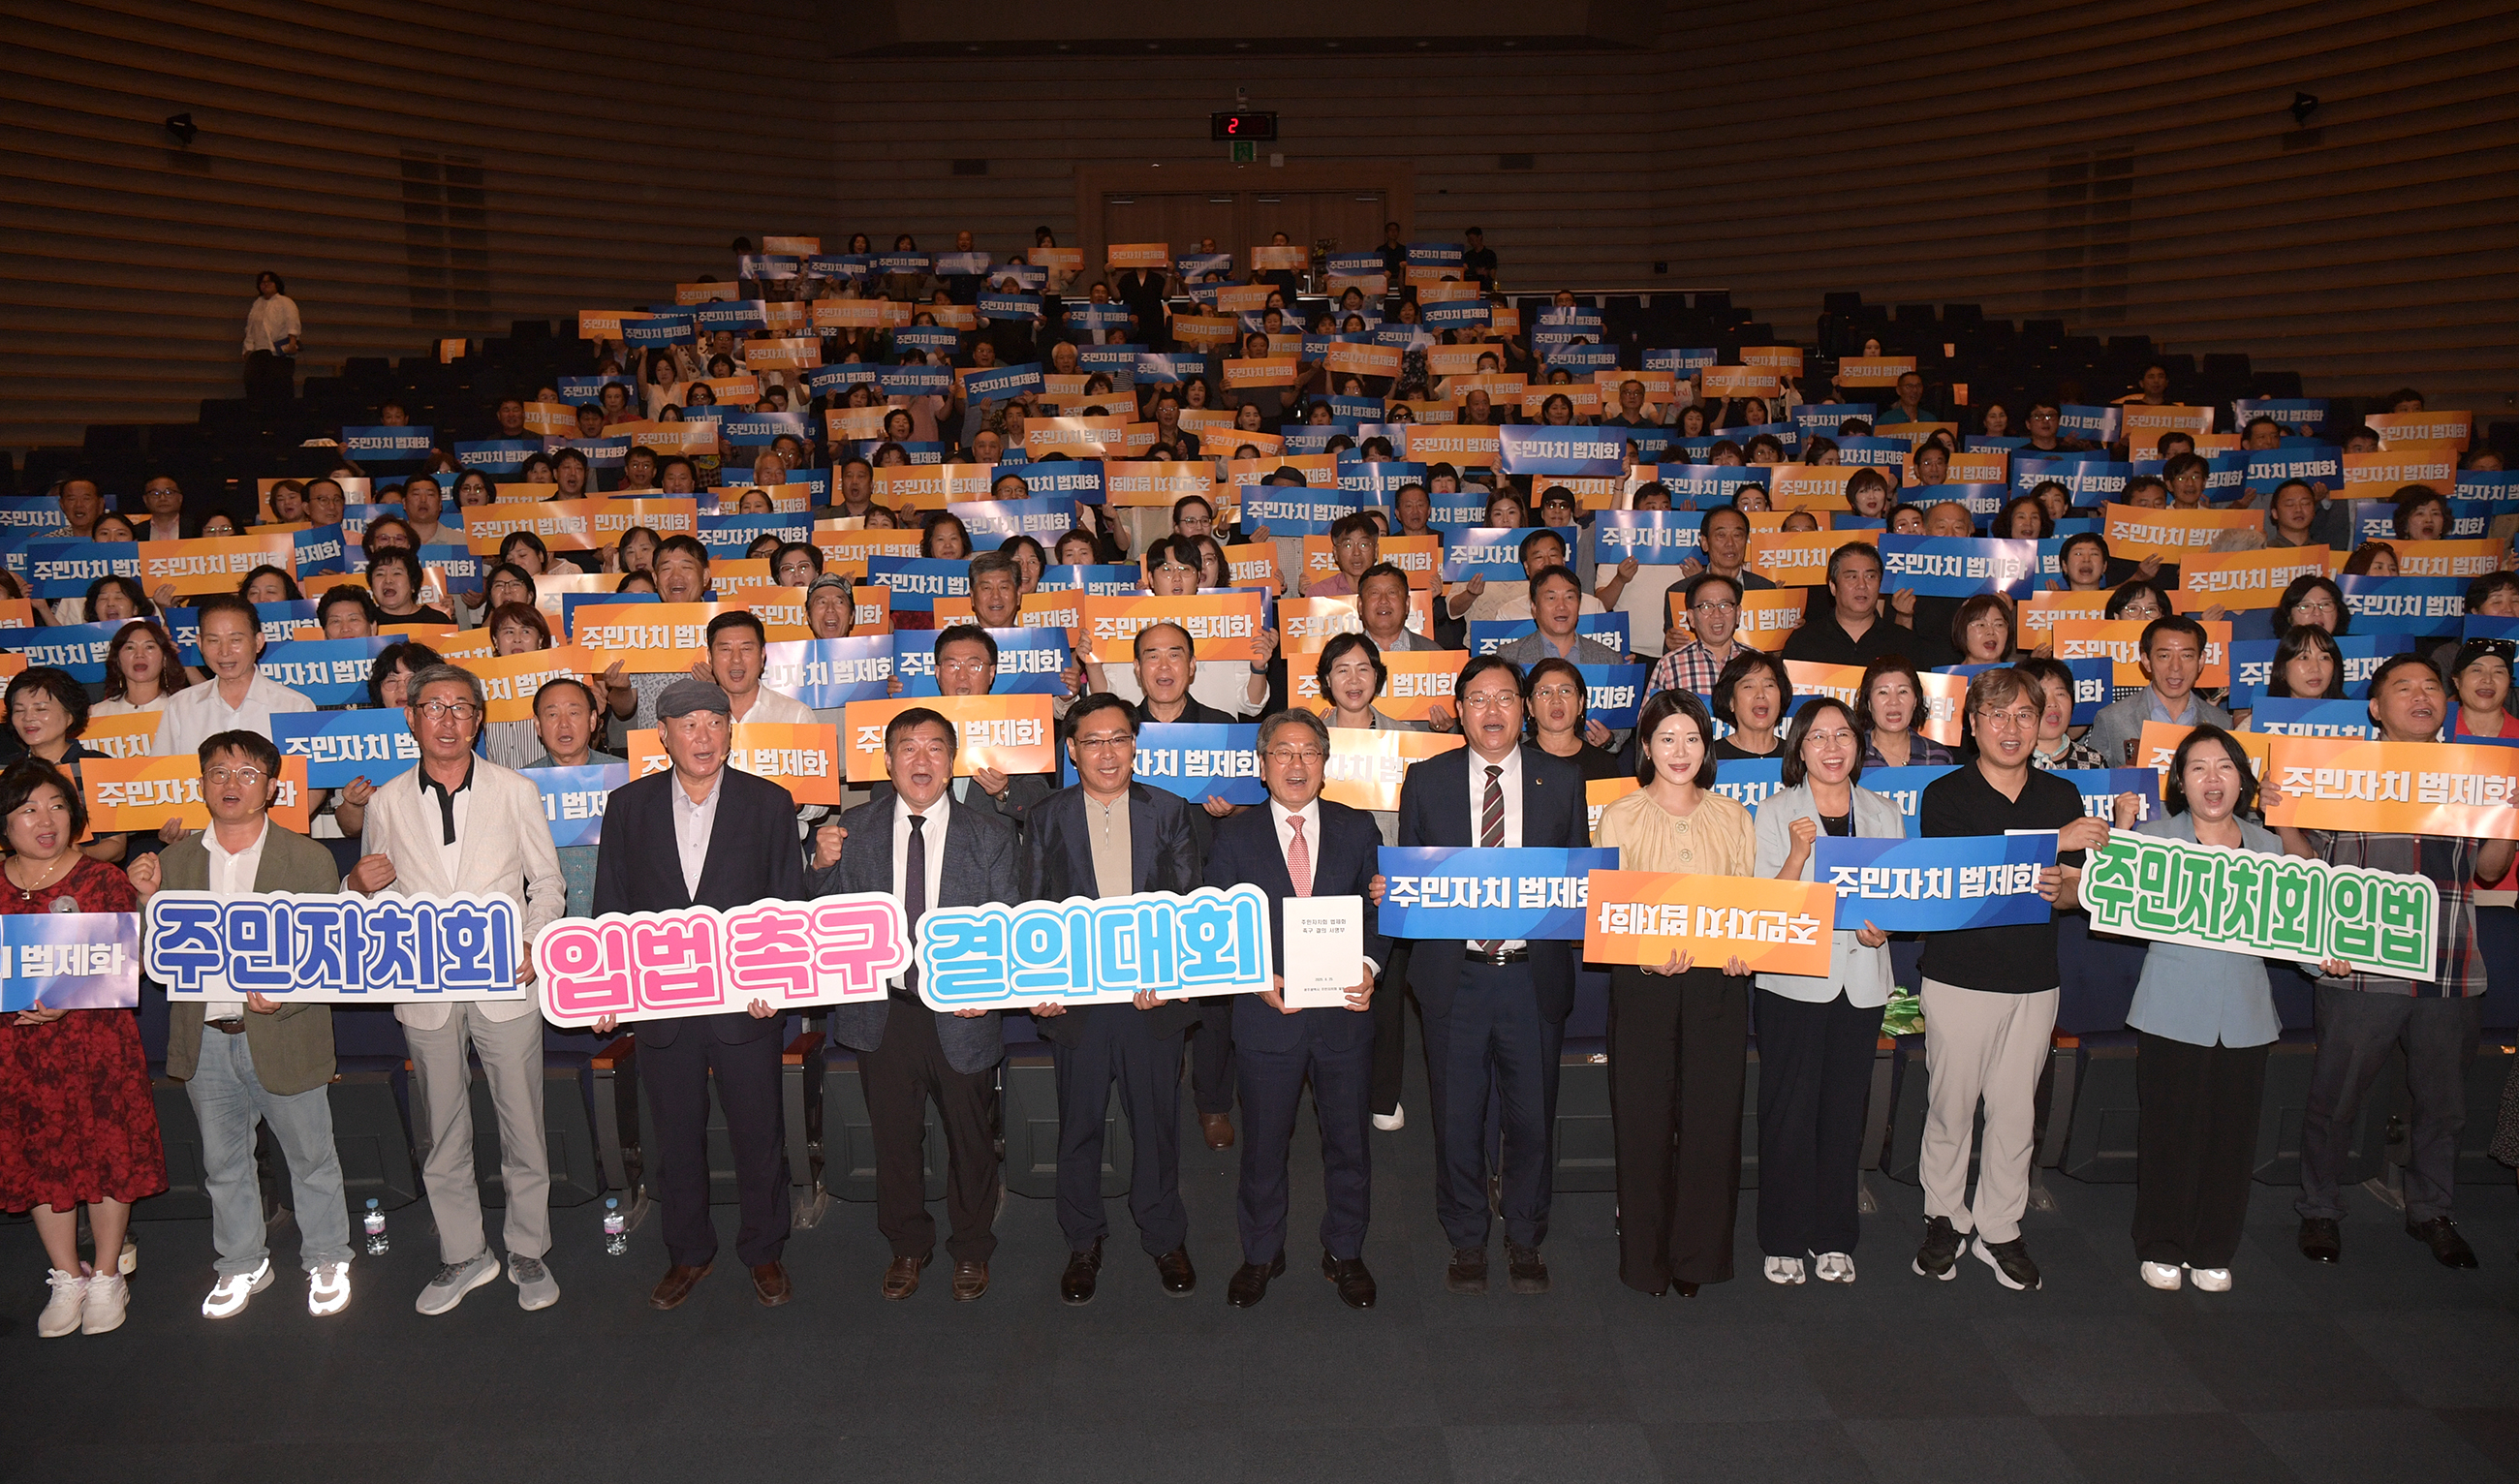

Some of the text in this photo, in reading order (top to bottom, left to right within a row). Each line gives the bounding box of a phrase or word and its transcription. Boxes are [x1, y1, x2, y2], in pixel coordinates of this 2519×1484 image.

[1228, 118, 1238, 133] 2
[1409, 250, 1462, 260] 주민자치 법제화
[812, 262, 866, 273] 주민자치 법제화
[880, 259, 906, 267] 주민자치
[1221, 293, 1252, 302] 주민자치
[980, 300, 1040, 313] 주민자치 법제화
[699, 310, 733, 321] 주민자치
[736, 310, 763, 321] 법제화
[1104, 312, 1128, 322] 법제화
[1426, 309, 1488, 321] 주민자치 법제화
[1540, 315, 1601, 325] 주민자치 법제화
[583, 320, 620, 329] 주민자치
[626, 325, 690, 338] 주민자치 법제화
[1175, 324, 1233, 335] 주민자치 법제화
[897, 335, 956, 345] 주민자치 법제화
[1378, 331, 1412, 341] 주민자치
[1536, 333, 1570, 343] 주민자치
[749, 349, 817, 358] 주민자치 법제화
[1081, 352, 1116, 362] 주민자치
[1330, 351, 1397, 367] 주민자치 법제화
[1432, 355, 1469, 364] 주민자치
[1548, 355, 1616, 364] 주민자치 법제화
[1744, 356, 1800, 366] 주민자치 법제화
[1137, 362, 1203, 374] 주민자치 법제화
[1647, 357, 1713, 369] 주민자치 법제화
[1843, 365, 1912, 376] 주민자치 법제화
[813, 371, 876, 387] 주민자치 법제화
[1228, 366, 1292, 378] 주민자치 법제화
[882, 375, 949, 386] 주민자치 법제화
[970, 372, 1041, 393] 주민자치 법제화
[1706, 376, 1776, 386] 주민자치 법제화
[727, 386, 755, 395] 법제화
[1495, 384, 1523, 393] 법제화
[552, 414, 575, 425] 법제화
[1353, 407, 1381, 418] 법제화
[1422, 411, 1454, 421] 법제화
[2289, 409, 2323, 421] 법제화
[831, 418, 872, 430] 주민자치
[1796, 415, 1838, 426] 주민자치
[2128, 416, 2172, 427] 주민자치
[727, 424, 769, 436] 주민자치
[1030, 428, 1122, 445] 주민자치 법제화
[2432, 424, 2467, 438] 법제화
[348, 438, 429, 448] 주민자치 법제화
[638, 432, 713, 444] 주민자치 법제화
[1127, 434, 1155, 446] 법제화
[1205, 435, 1279, 454] 주민자치 법제화
[1286, 436, 1326, 447] 주민자치
[1412, 438, 1464, 452] 주민자치
[461, 451, 502, 464] 주민자치
[596, 447, 628, 457] 법제화
[910, 452, 942, 464] 법제화
[1508, 442, 1620, 459] 주민자치 법제화
[1874, 450, 1905, 464] 법제화
[1962, 467, 2001, 480] 법제화
[2289, 461, 2337, 478] 법제화
[2404, 464, 2449, 479] 법제화
[892, 477, 991, 495] 주민자치 법제화
[1057, 475, 1100, 491] 법제화
[1108, 477, 1211, 492] 주민자치 법제화
[1662, 478, 1718, 495] 주민자치
[1779, 480, 1836, 495] 주민자치
[2082, 475, 2126, 491] 법제화
[1248, 502, 1309, 520] 주민자치
[1965, 498, 2001, 512] 법제화
[472, 516, 586, 539] 주민자치 법제화
[644, 513, 690, 531] 법제화
[1023, 513, 1071, 531] 법제화
[698, 530, 755, 544] 주민자치
[1602, 528, 1670, 546] 주민자치
[2112, 521, 2185, 545] 주민자치
[822, 544, 883, 563] 주민자치
[1450, 546, 1519, 564] 주민자치
[1758, 549, 1825, 568] 주민자치
[149, 556, 225, 575] 주민자치
[1383, 552, 1432, 571] 법제화
[1885, 553, 2027, 578] 주민자치 법제화
[34, 561, 109, 580] 주민자치
[874, 573, 944, 594] 주민자치
[2189, 569, 2266, 592] 주민자치
[2346, 594, 2420, 616] 주민자치
[1023, 609, 1078, 628] 법제화
[1758, 608, 1801, 630] 법제화
[1187, 614, 1253, 639] 법제화
[582, 625, 669, 650] 주민자치
[996, 649, 1063, 672] 법제화
[833, 658, 893, 684] 법제화
[1393, 672, 1458, 697] 법제화
[966, 719, 1043, 746] 법제화
[285, 734, 389, 763] 주민자치
[755, 748, 828, 778] 법제화
[1185, 749, 1259, 778] 법제화
[2282, 767, 2516, 808] 주민자치 법제화
[1830, 863, 2041, 900] 주민자치 법제화
[1389, 877, 1510, 909] 주민자치
[2086, 837, 2432, 973] 주민자치회 입법
[1599, 901, 1820, 945] 주민자치 법제화
[153, 900, 517, 993] 주민자치회
[924, 892, 1263, 1004] 결의대회
[20, 943, 125, 978] 법제화
[542, 901, 904, 1018] 입법 촉구
